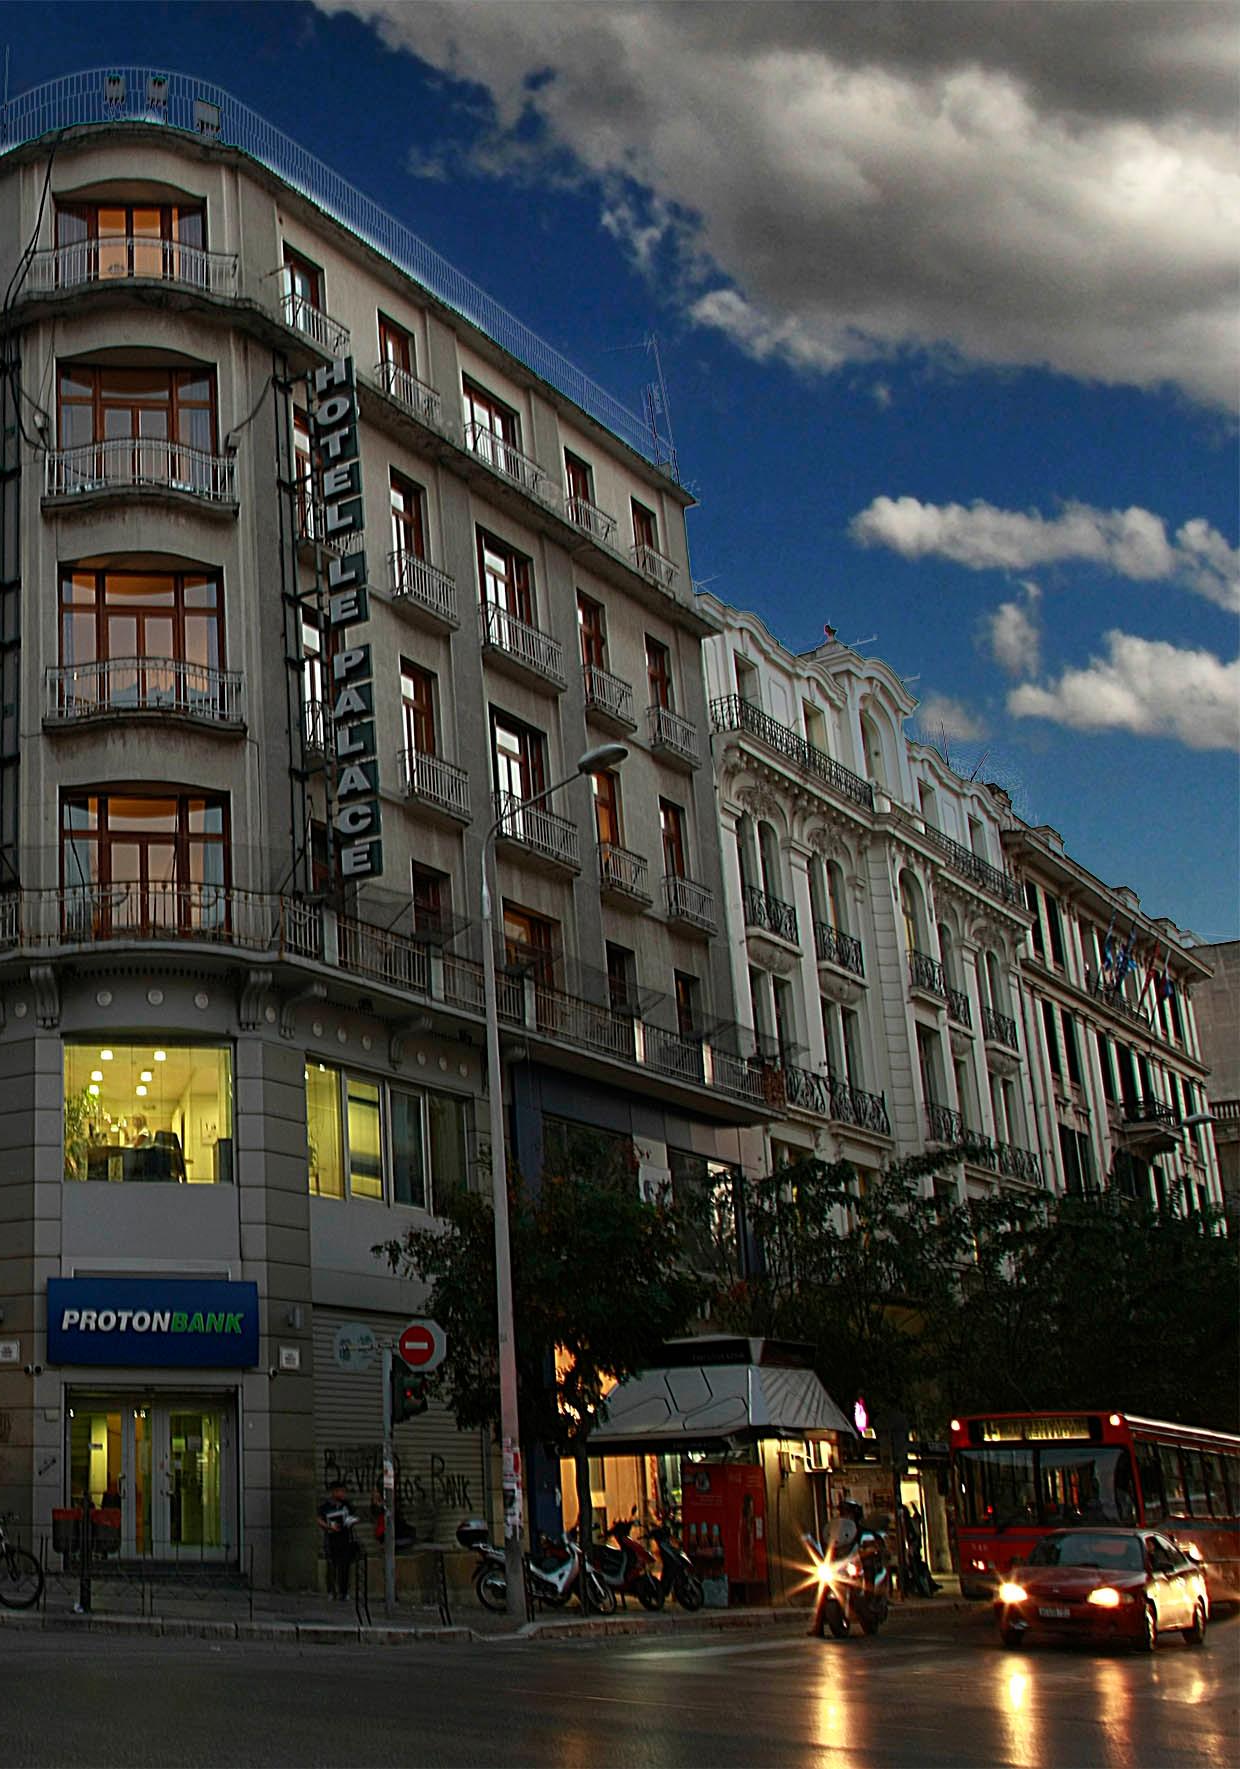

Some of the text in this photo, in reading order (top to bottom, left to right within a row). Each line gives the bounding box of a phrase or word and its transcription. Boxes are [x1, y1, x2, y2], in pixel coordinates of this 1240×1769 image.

[316, 357, 372, 876] HOTEL LE PALACE
